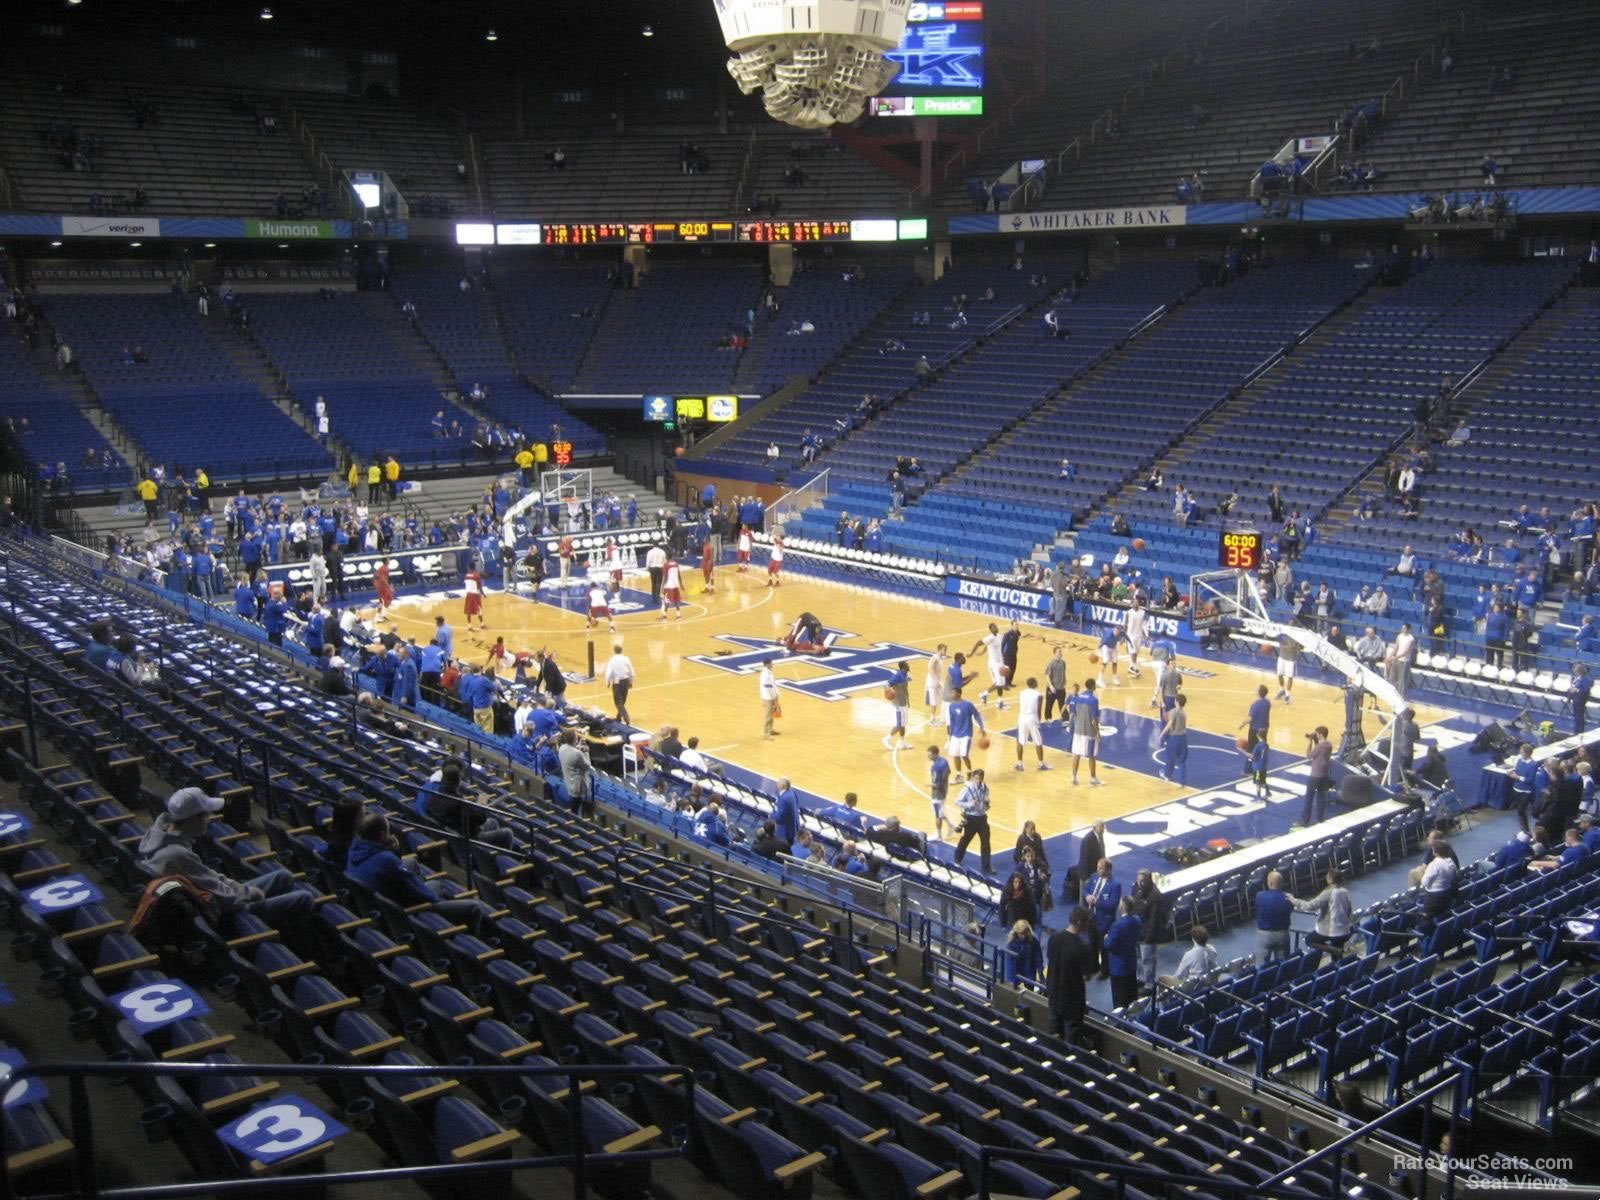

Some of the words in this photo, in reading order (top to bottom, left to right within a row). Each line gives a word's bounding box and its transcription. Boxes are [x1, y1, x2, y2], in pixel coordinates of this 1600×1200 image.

[924, 99, 971, 112] Preside
[109, 224, 144, 234] verizon
[259, 222, 318, 236] Humana
[1029, 211, 1115, 229] WHITAKER
[1123, 209, 1170, 225] BANK
[556, 451, 570, 464] 35
[1224, 534, 1256, 548] 60:00
[1228, 546, 1252, 566] 35
[959, 580, 1042, 608] KENTUCKY
[1091, 605, 1179, 636] WILATS
[29, 879, 91, 908] 3
[120, 983, 193, 1024] 3
[235, 1104, 326, 1154] 3
